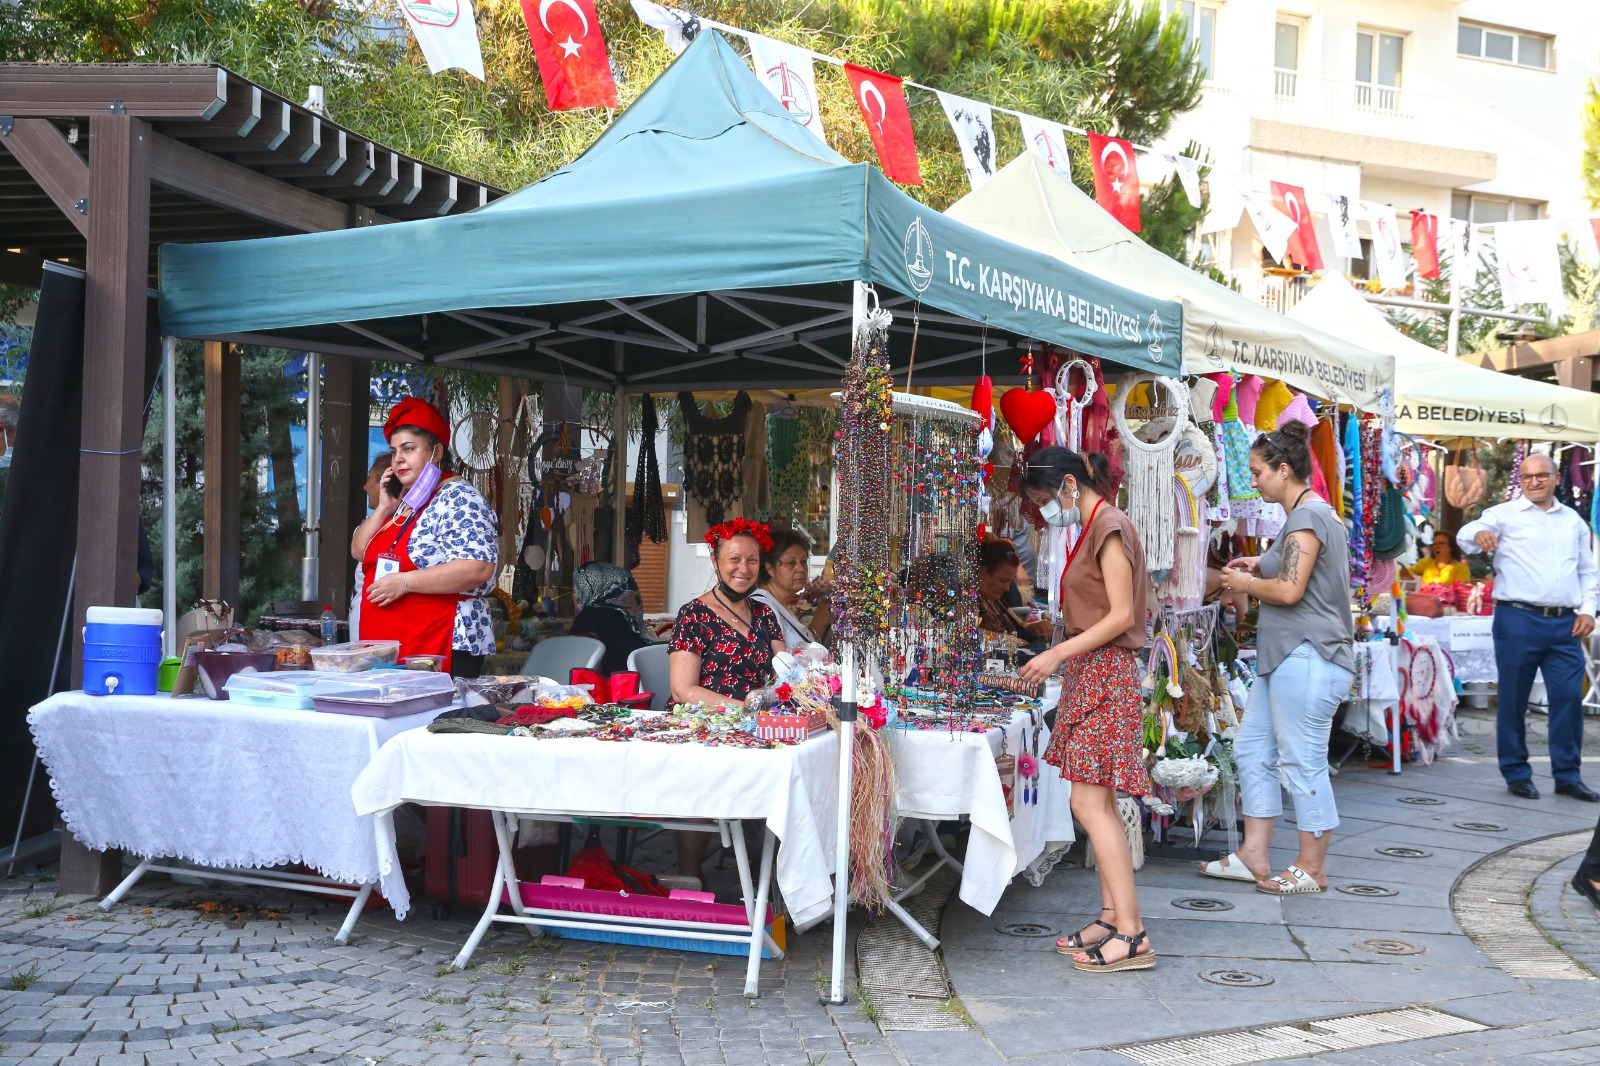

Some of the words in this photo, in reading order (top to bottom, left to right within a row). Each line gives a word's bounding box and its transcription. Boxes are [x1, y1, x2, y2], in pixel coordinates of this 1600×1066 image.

[945, 250, 975, 292] T.C.
[979, 263, 1066, 321] KARŞIYAKA
[1068, 294, 1143, 345] BELEDİYESİ
[1231, 340, 1251, 366] T.C.
[1253, 344, 1315, 376] KARŞIYAKA
[1316, 360, 1367, 393] BELEDİYESİ
[1417, 405, 1527, 425] BELEDİYESİ
